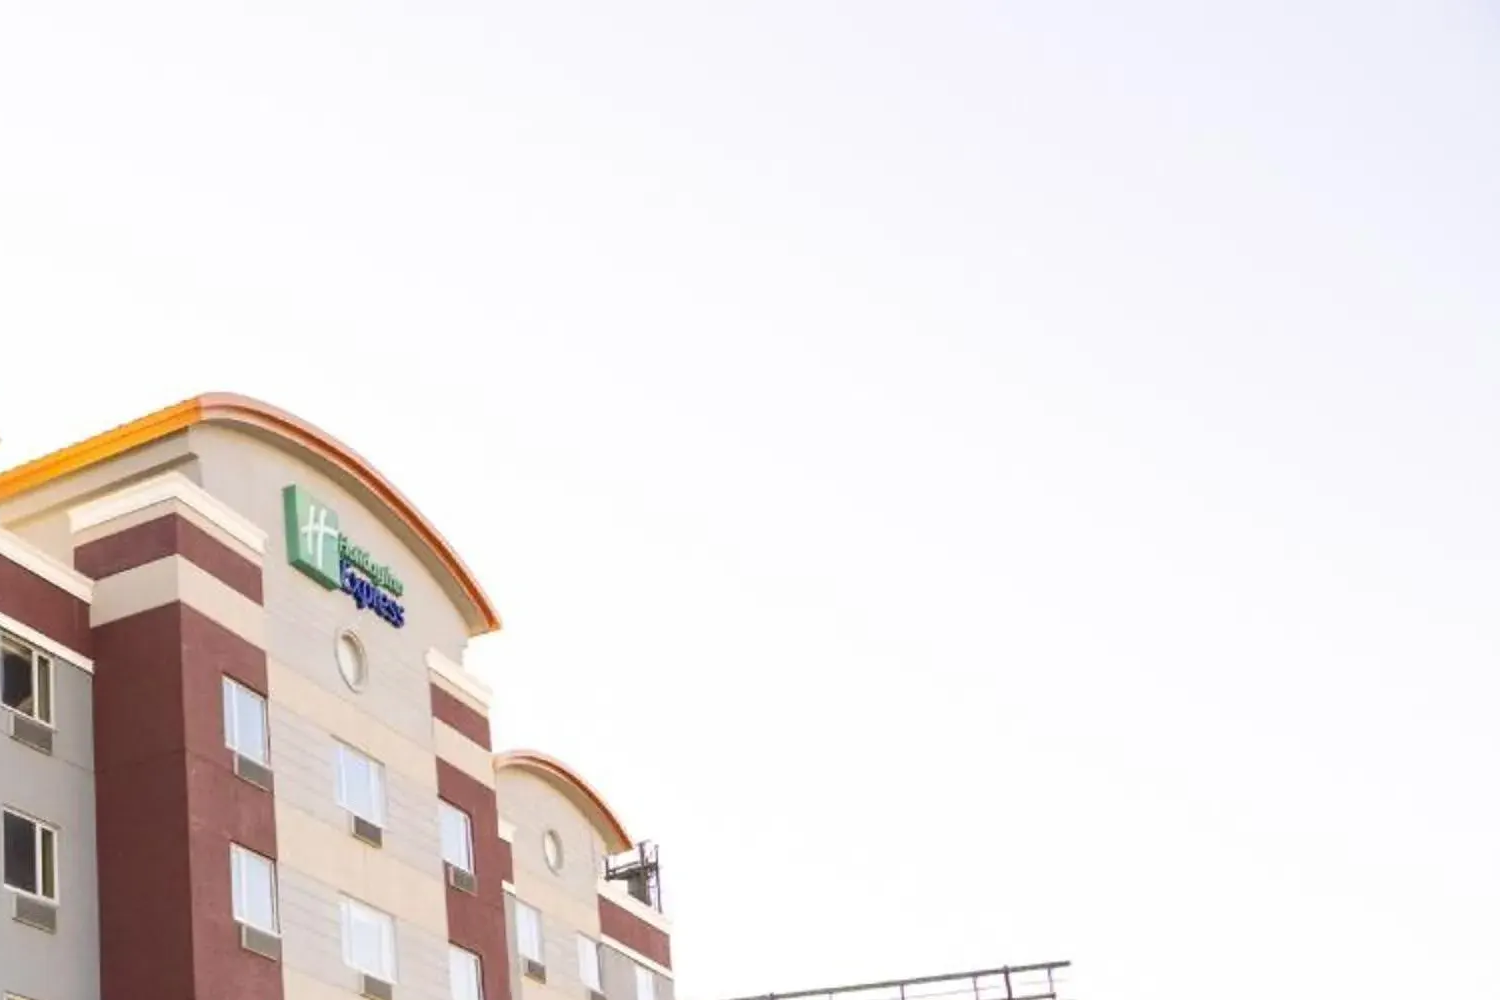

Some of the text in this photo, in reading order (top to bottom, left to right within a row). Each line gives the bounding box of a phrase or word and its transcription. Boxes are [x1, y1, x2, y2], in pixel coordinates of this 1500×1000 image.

[338, 533, 403, 597] Holiday Inn
[340, 559, 405, 628] Express
